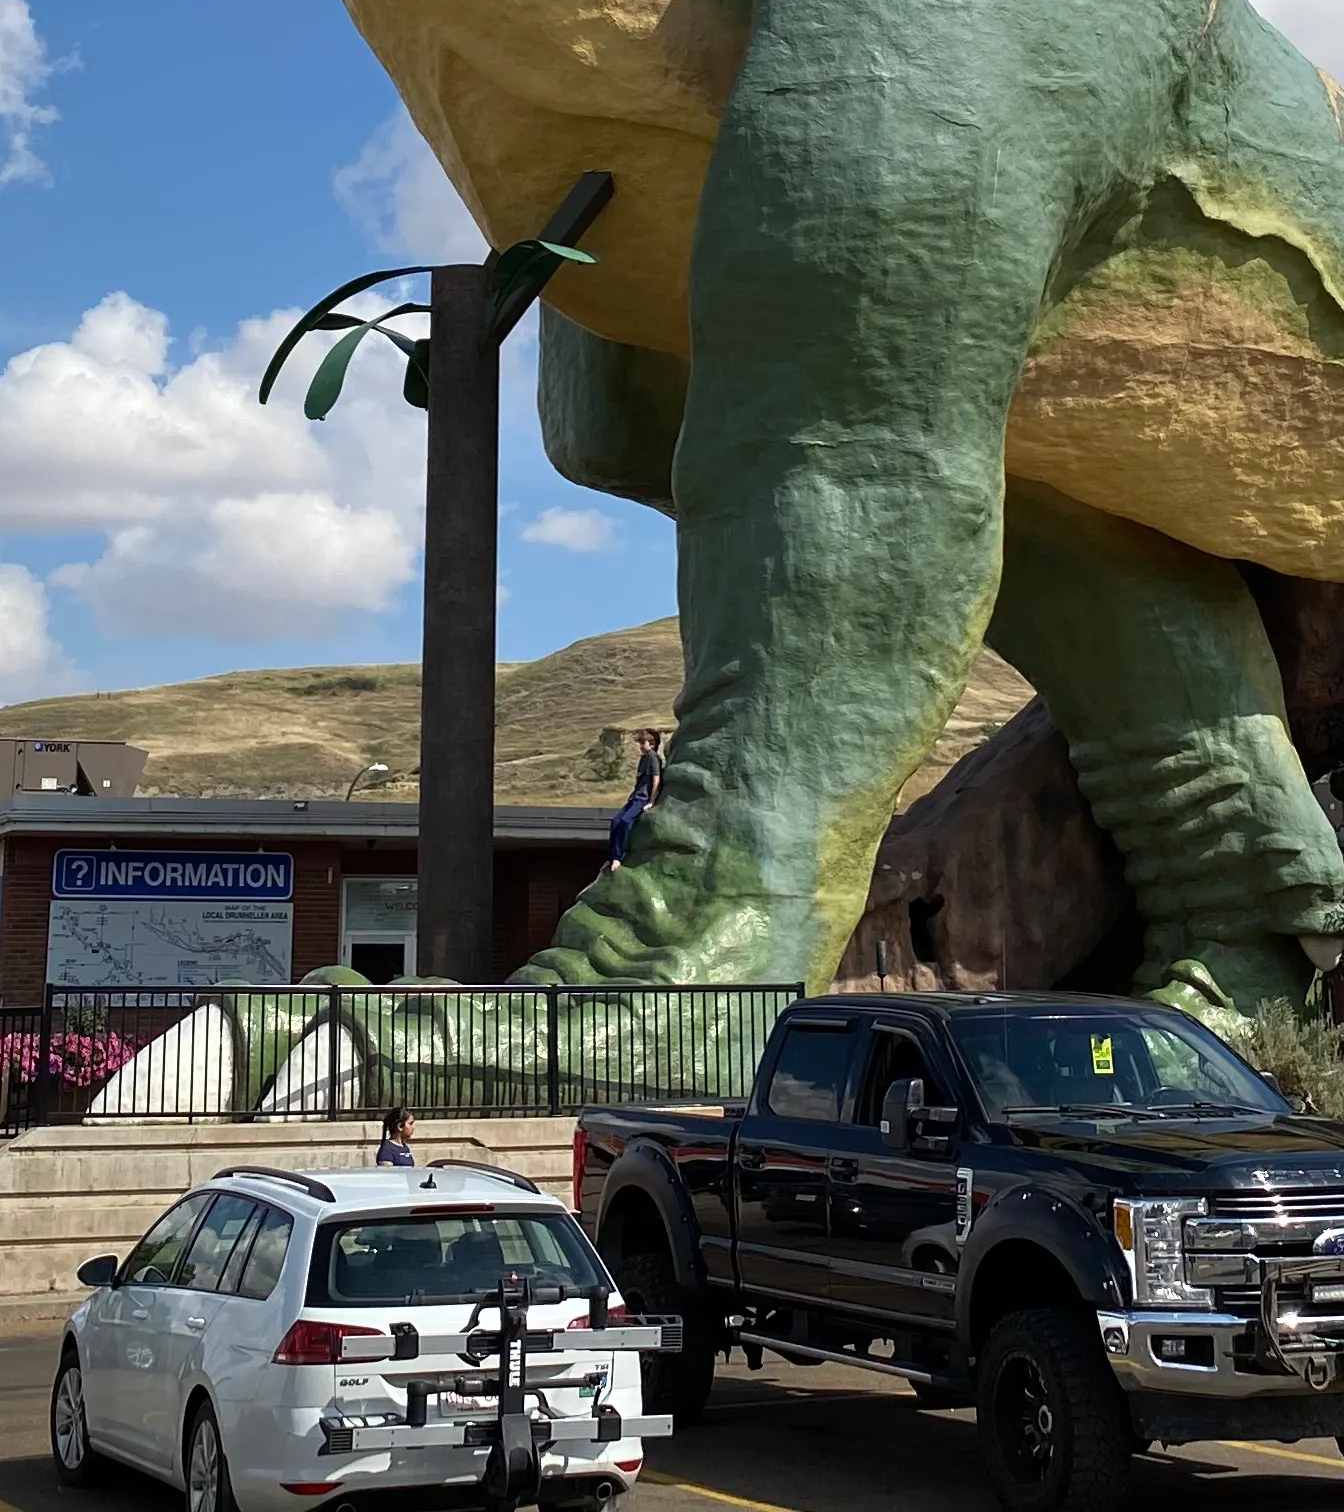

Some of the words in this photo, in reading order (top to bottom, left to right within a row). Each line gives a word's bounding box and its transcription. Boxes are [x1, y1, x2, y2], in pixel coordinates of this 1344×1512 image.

[44, 743, 71, 753] YORK
[100, 861, 285, 888] INFORMATION
[202, 911, 224, 919] LOCAL
[225, 911, 270, 919] DRUMHELLER
[271, 912, 288, 920] AREA
[509, 1339, 522, 1388] THULE
[339, 1378, 369, 1387] GOLF
